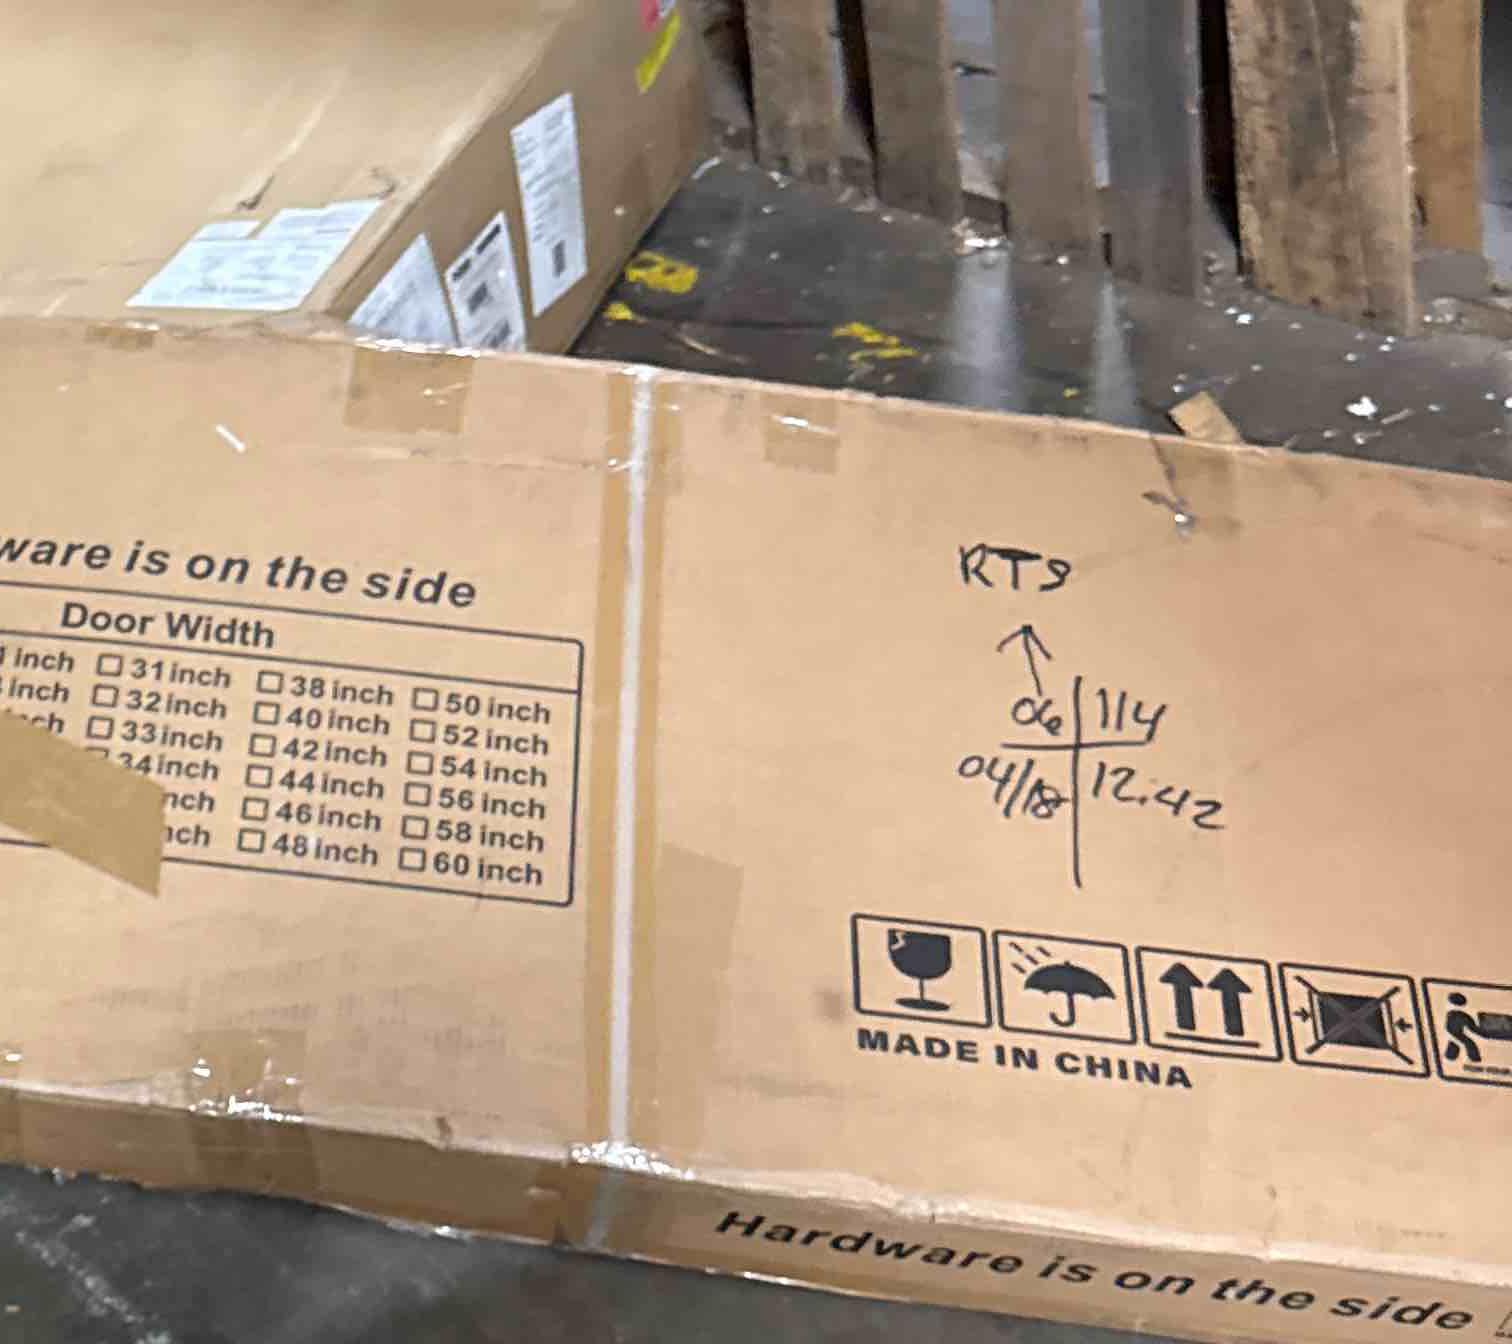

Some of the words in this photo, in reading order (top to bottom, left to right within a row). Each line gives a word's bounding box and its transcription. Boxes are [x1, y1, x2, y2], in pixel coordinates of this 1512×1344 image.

[122, 538, 171, 577] is
[184, 552, 251, 585] on
[264, 554, 349, 595] the
[360, 566, 477, 609] side
[59, 600, 156, 636] Door
[163, 609, 275, 649] Width
[12, 646, 75, 674] inch
[129, 656, 165, 681] 31
[168, 660, 232, 689] inch
[8, 675, 70, 704] inch
[124, 688, 162, 713] 32
[164, 691, 228, 720] inch
[289, 673, 326, 699] 38
[330, 678, 395, 707] inch
[284, 705, 323, 731] 40
[326, 707, 391, 736] inch
[443, 690, 481, 717] 50
[486, 695, 551, 725] inch
[120, 718, 157, 744] 33
[159, 723, 224, 753] inch
[281, 736, 319, 762] 42
[323, 738, 388, 768] inch
[441, 722, 480, 749] 52
[484, 727, 549, 757] inch
[117, 749, 153, 775] 34
[155, 753, 221, 782] inch
[438, 754, 477, 780] 54
[482, 758, 548, 789] inch
[159, 789, 216, 814] nch
[277, 767, 316, 793] 44
[319, 771, 385, 801] inch
[274, 799, 313, 825] 46
[316, 802, 382, 833] inch
[437, 785, 475, 812] 56
[480, 790, 547, 821] inch
[270, 831, 309, 858] 48
[312, 836, 379, 867] inch
[434, 817, 473, 844] 58
[478, 822, 545, 854] inch
[431, 850, 470, 877] 60
[476, 856, 543, 886] inch
[855, 1026, 980, 1064] MADE
[992, 1042, 1040, 1071] IN
[1053, 1050, 1193, 1090] CHINA
[714, 1210, 1024, 1274] Hardware
[1036, 1254, 1097, 1283] is
[1112, 1270, 1196, 1296] on
[1209, 1275, 1316, 1311] the
[1327, 1294, 1474, 1330] side
